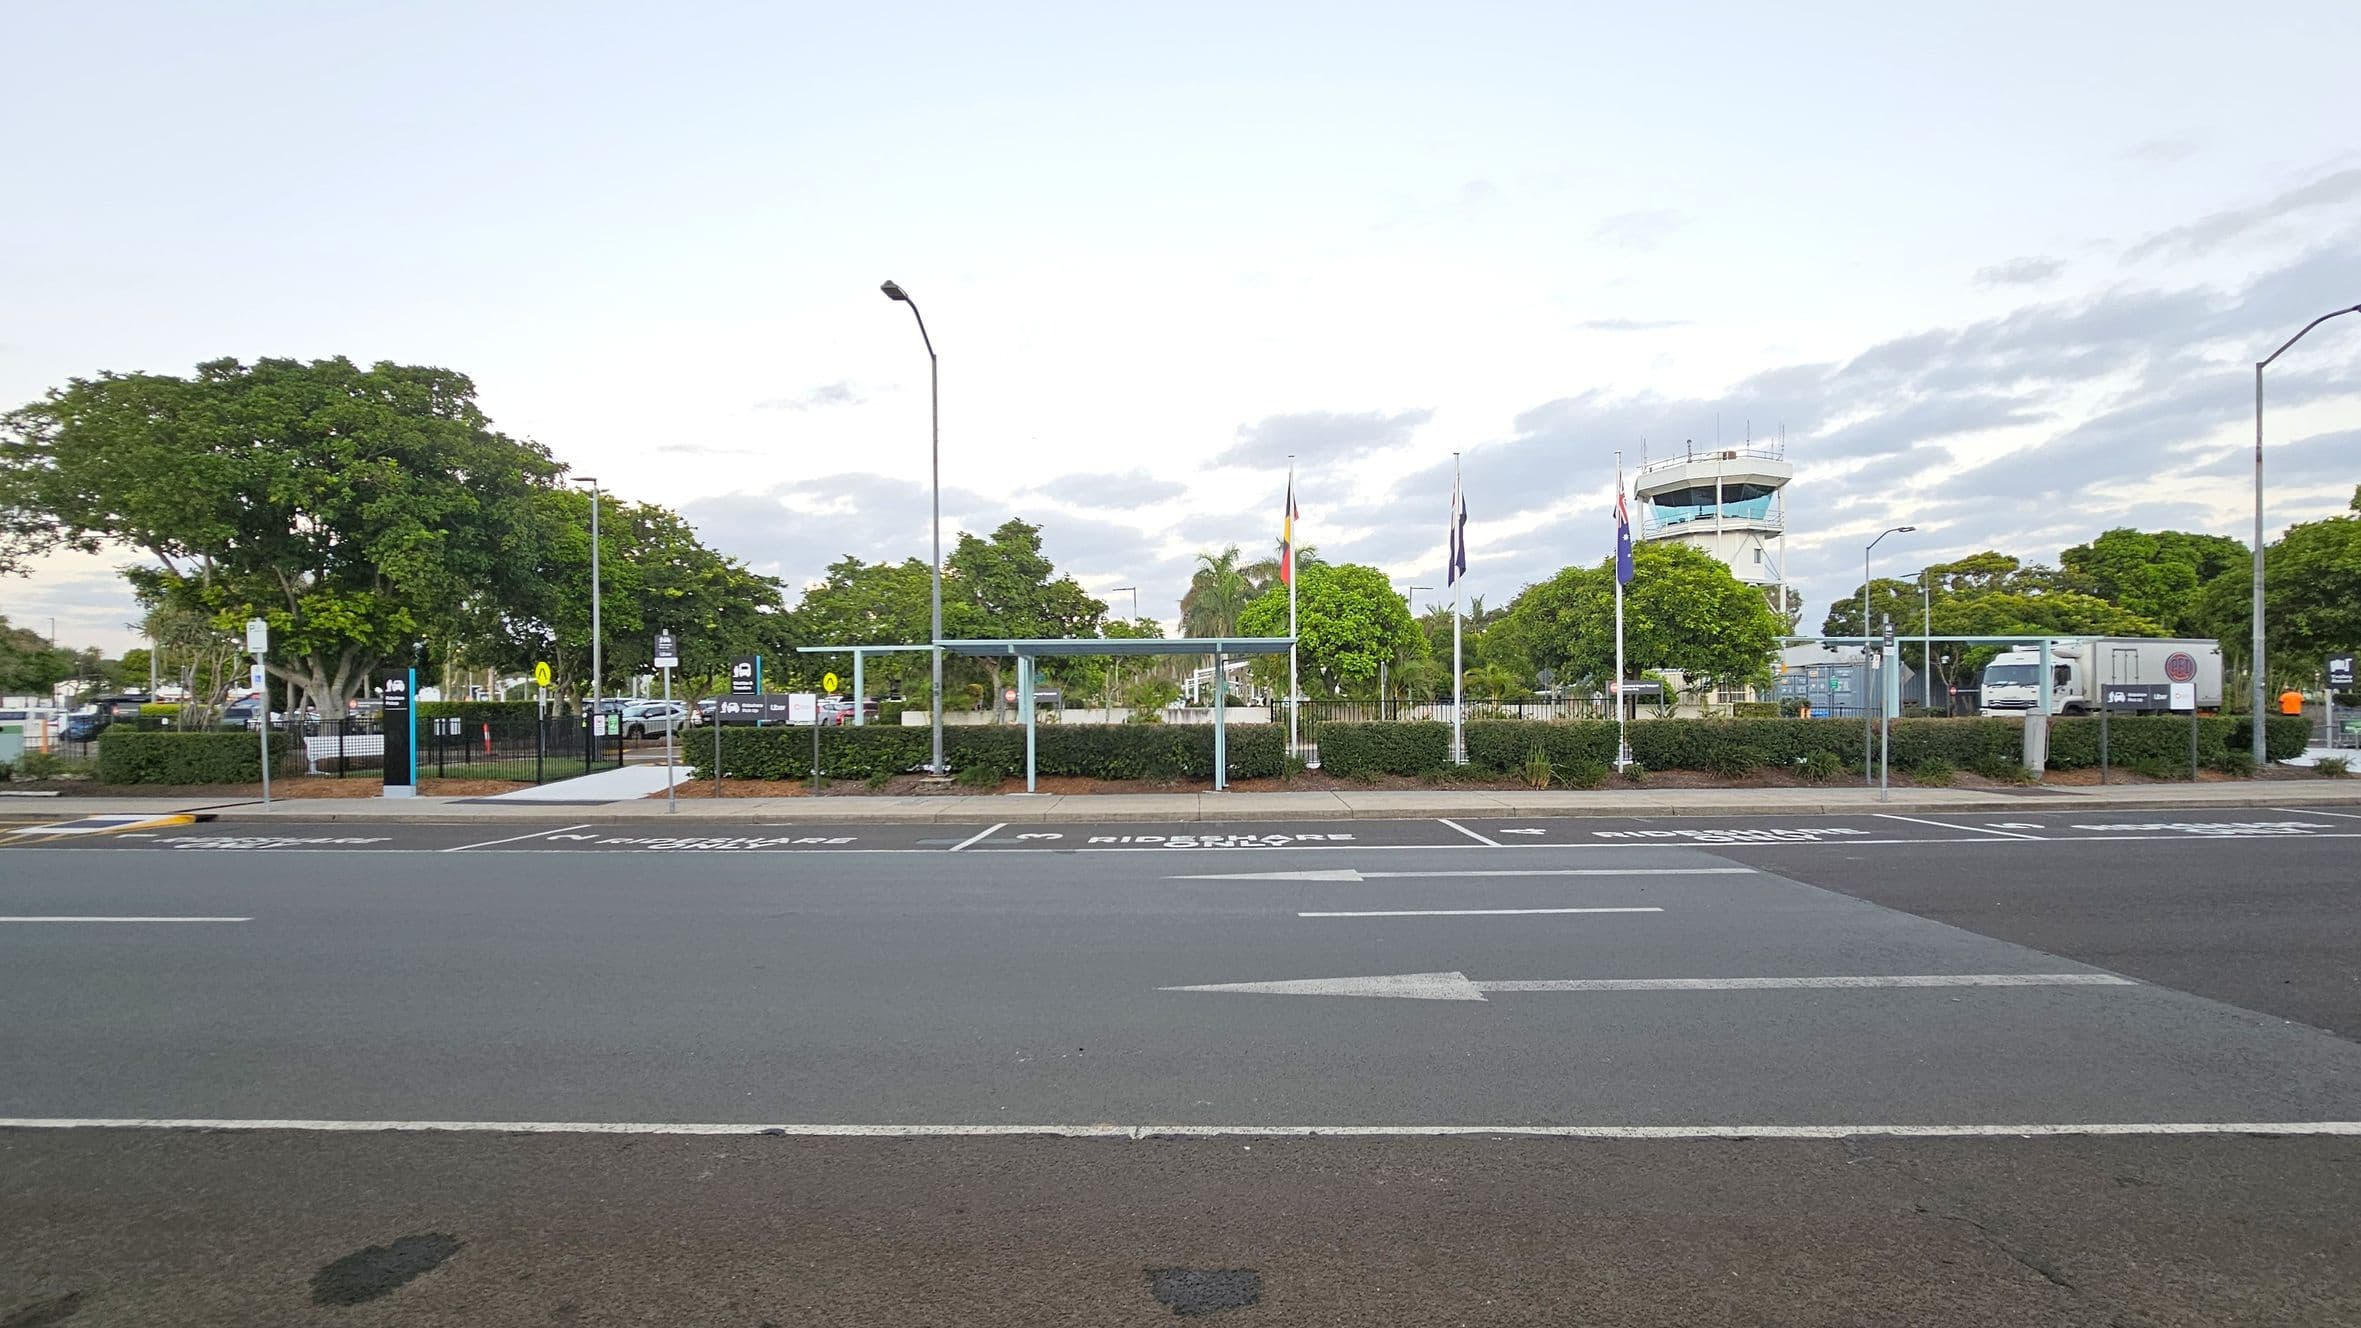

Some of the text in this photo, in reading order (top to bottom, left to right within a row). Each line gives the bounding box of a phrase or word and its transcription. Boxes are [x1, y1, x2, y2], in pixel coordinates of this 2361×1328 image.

[1016, 832, 1063, 840] 3
[1088, 833, 1356, 844] RIDESHARE
[1163, 840, 1290, 848] ONLY
